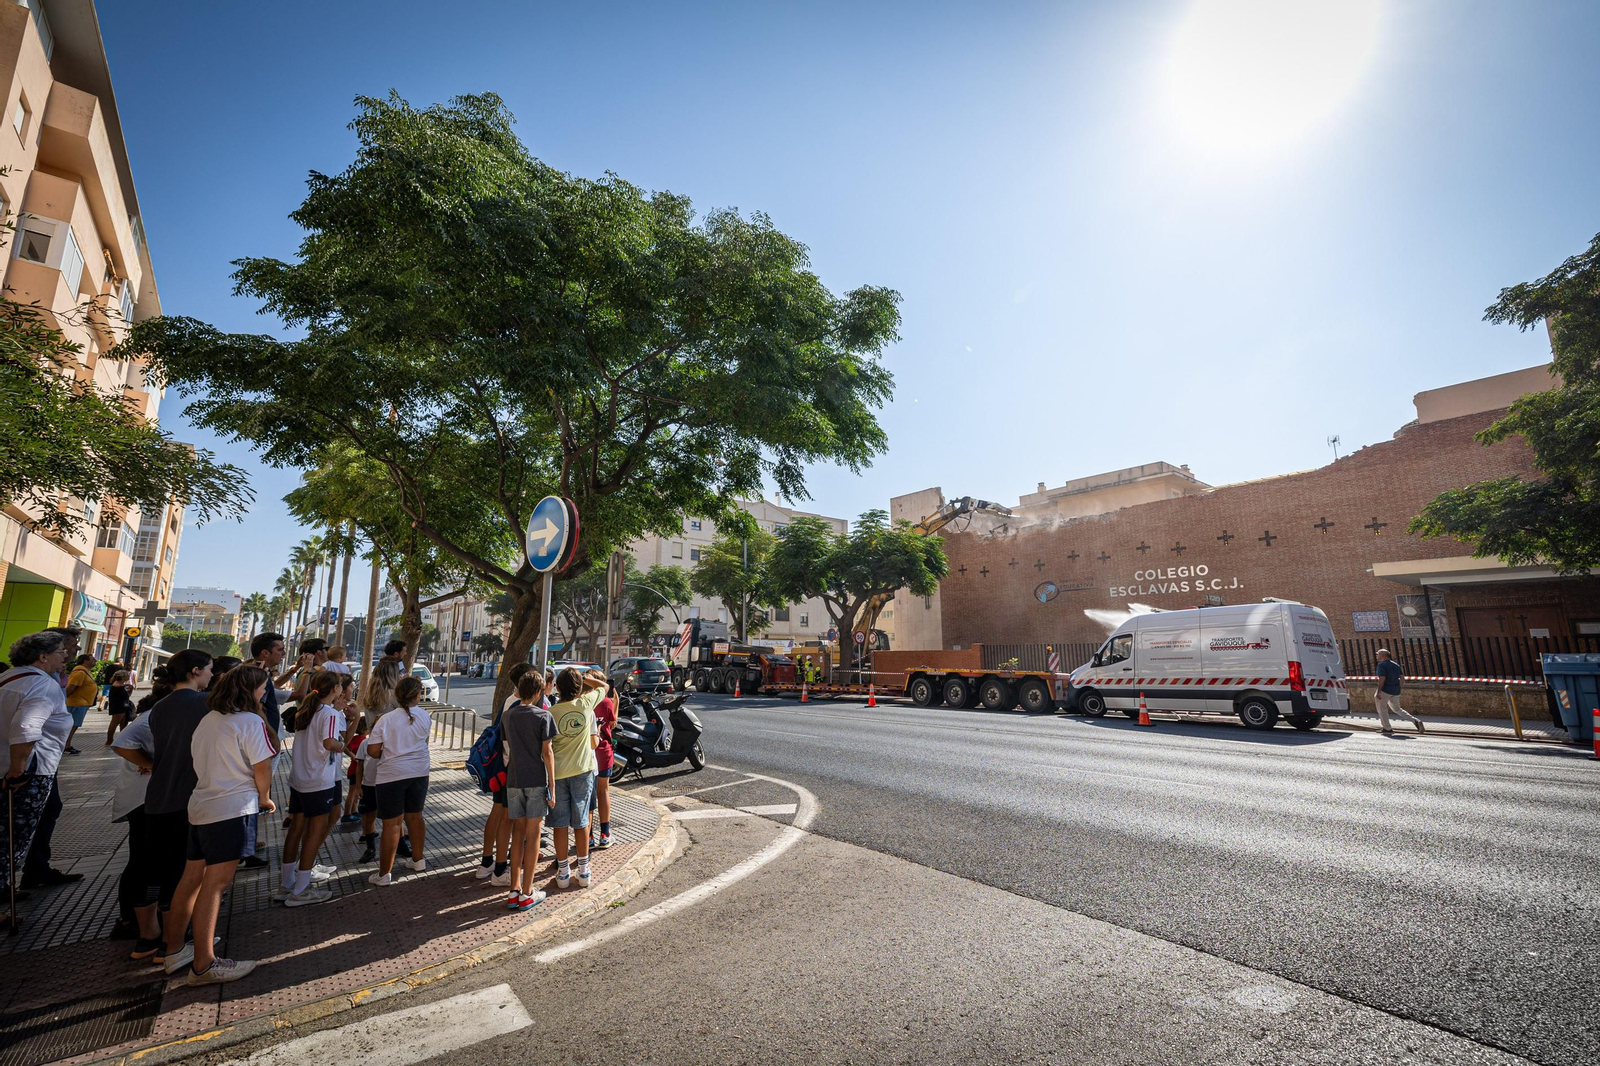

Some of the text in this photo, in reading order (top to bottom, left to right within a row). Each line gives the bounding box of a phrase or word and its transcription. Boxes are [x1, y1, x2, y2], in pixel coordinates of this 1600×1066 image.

[1134, 564, 1209, 581] COLEGIO
[1109, 577, 1244, 598] ESCLAVAS S.C.J.
